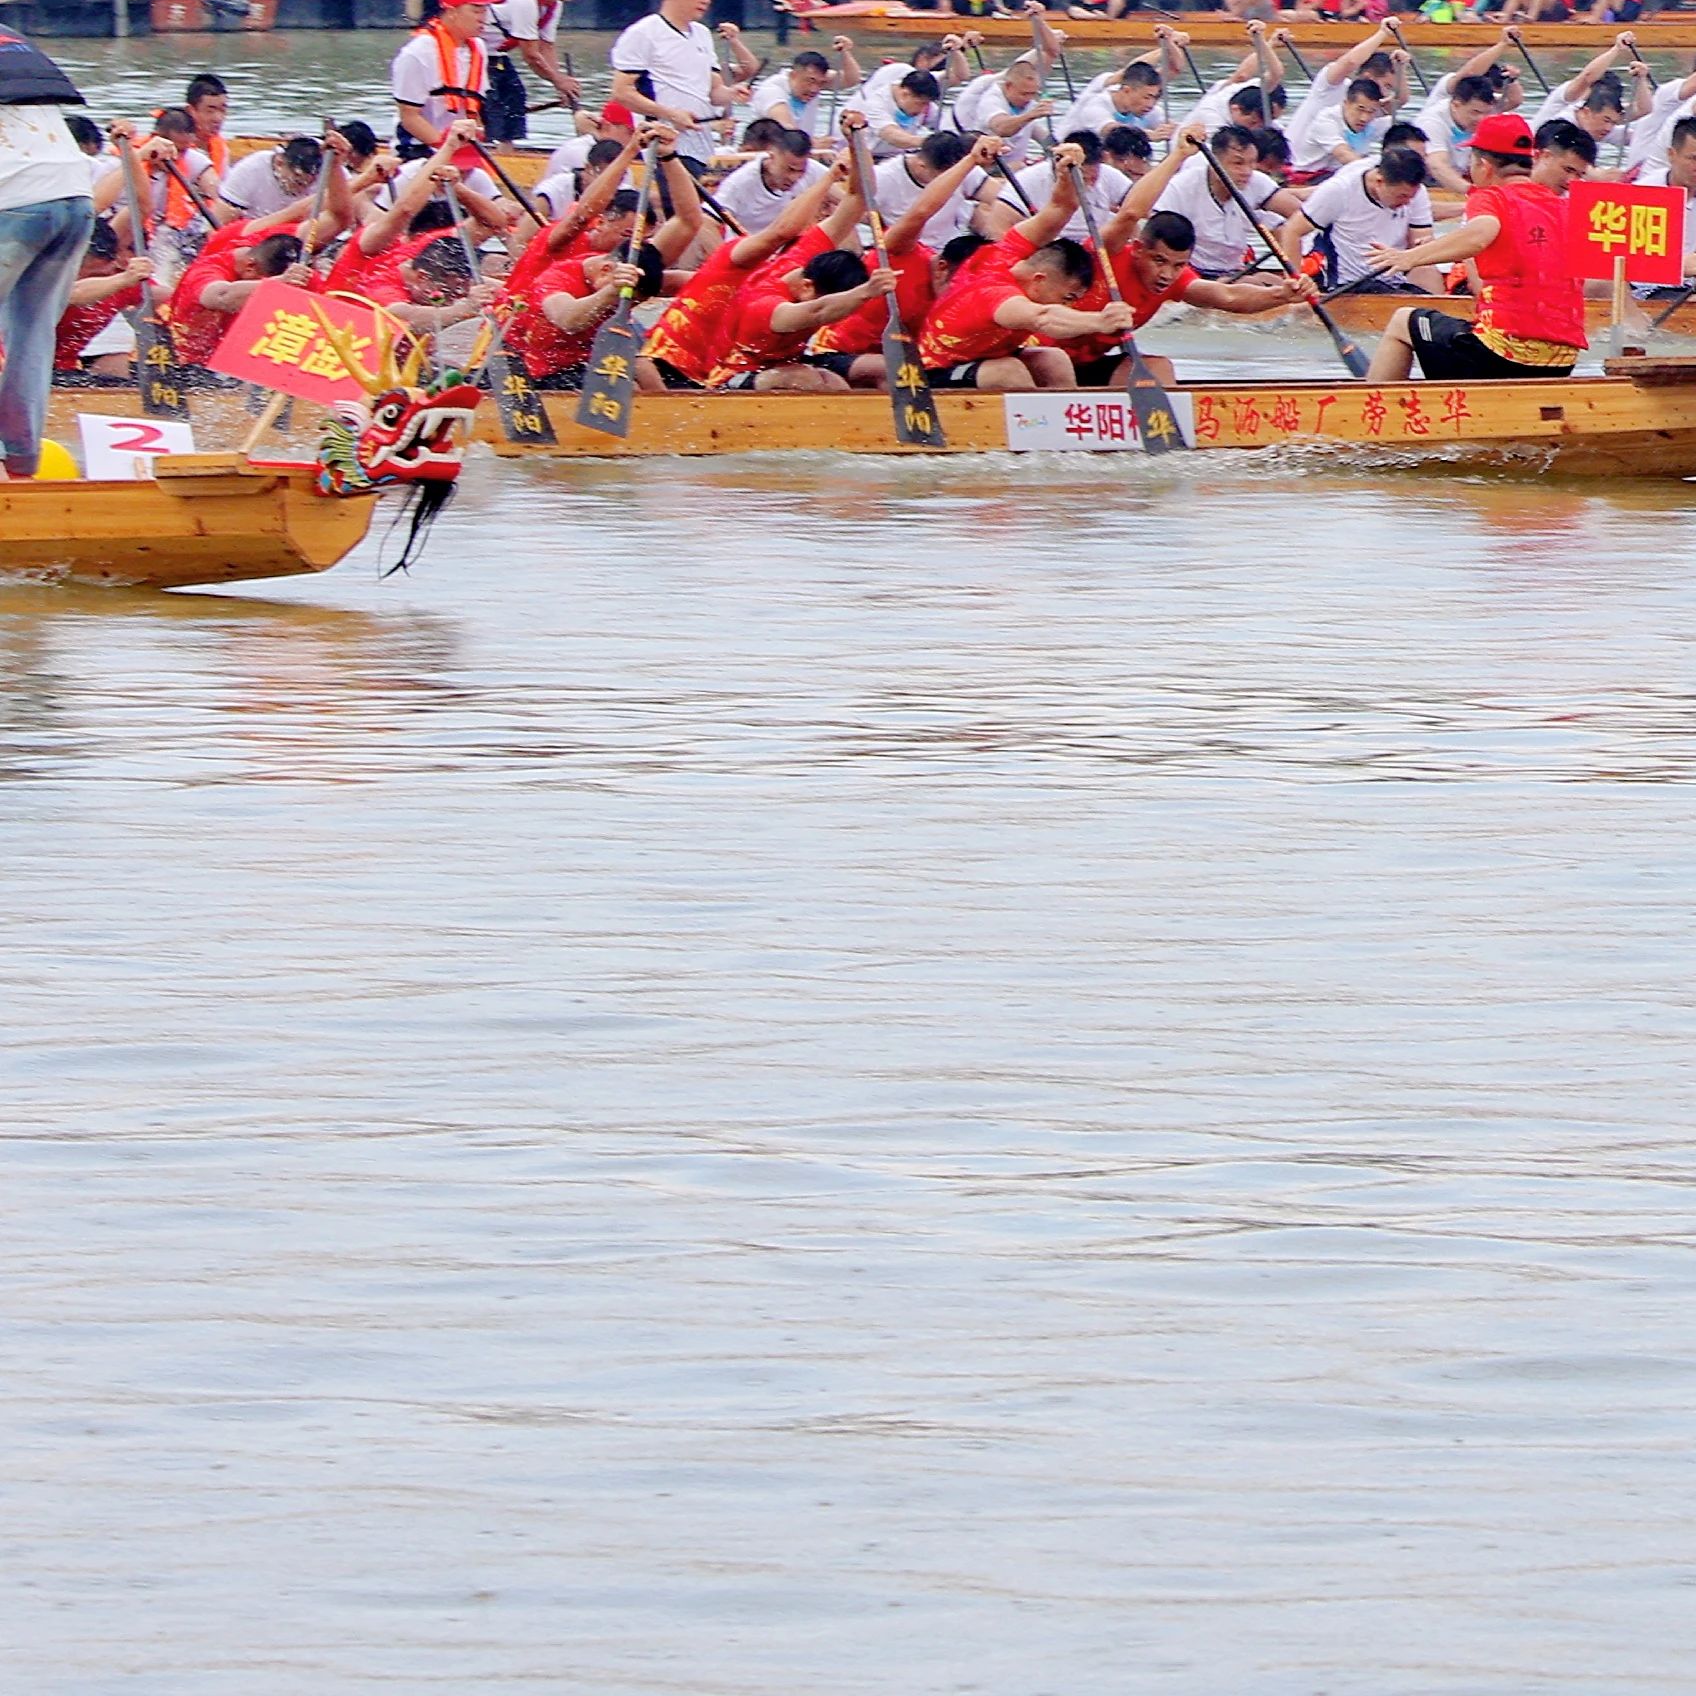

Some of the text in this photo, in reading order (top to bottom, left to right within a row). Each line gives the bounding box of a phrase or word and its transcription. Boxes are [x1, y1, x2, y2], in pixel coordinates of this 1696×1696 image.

[1588, 200, 1668, 257] 华阳
[502, 374, 542, 435] 华阳
[589, 355, 629, 422] 华阳
[895, 363, 932, 435] 华阳
[106, 422, 171, 454] 2
